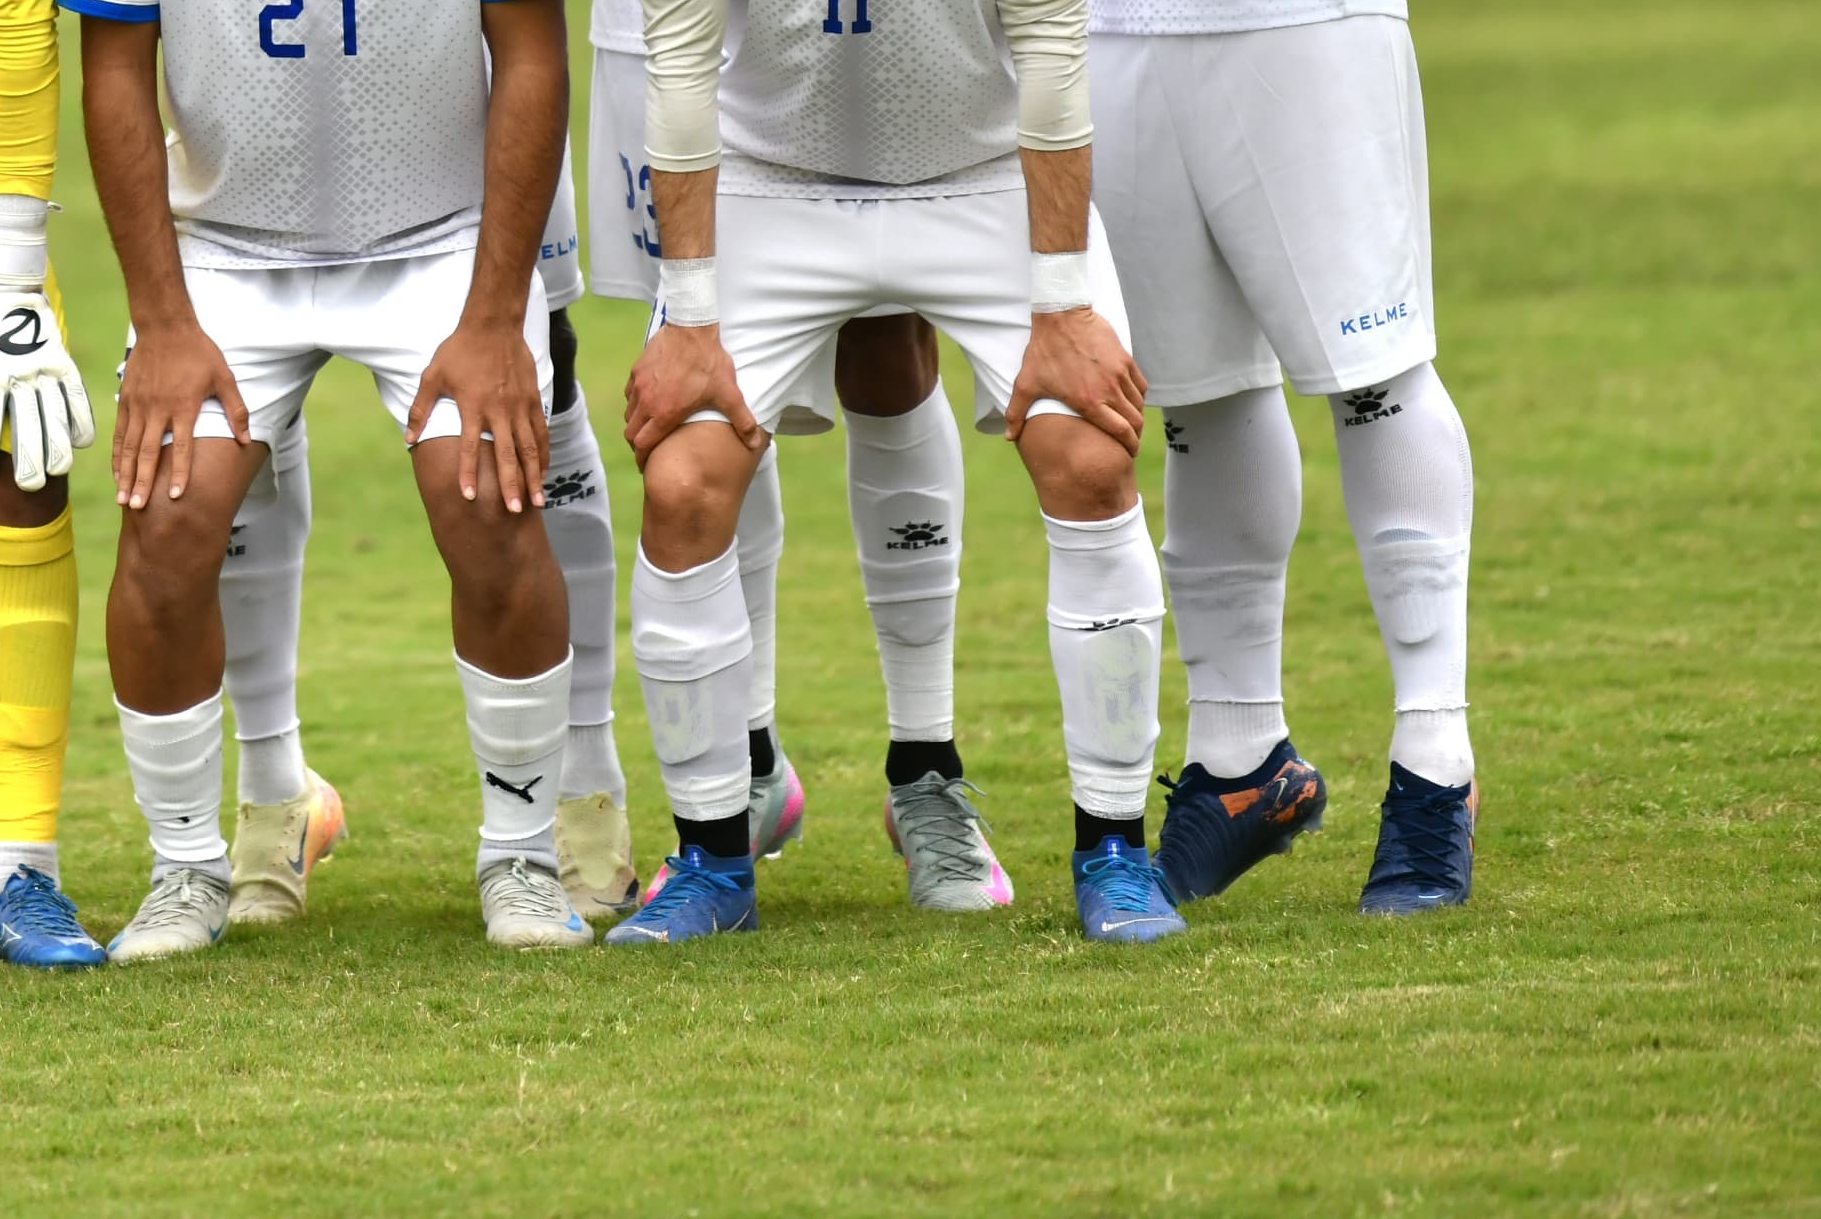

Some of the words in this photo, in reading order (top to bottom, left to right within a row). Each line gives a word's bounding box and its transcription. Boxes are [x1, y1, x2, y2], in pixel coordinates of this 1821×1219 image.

[541, 234, 577, 260] ELM
[1340, 302, 1408, 335] KELME
[1344, 403, 1403, 427] KELME
[545, 485, 596, 509] ELME
[887, 536, 948, 550] KELME
